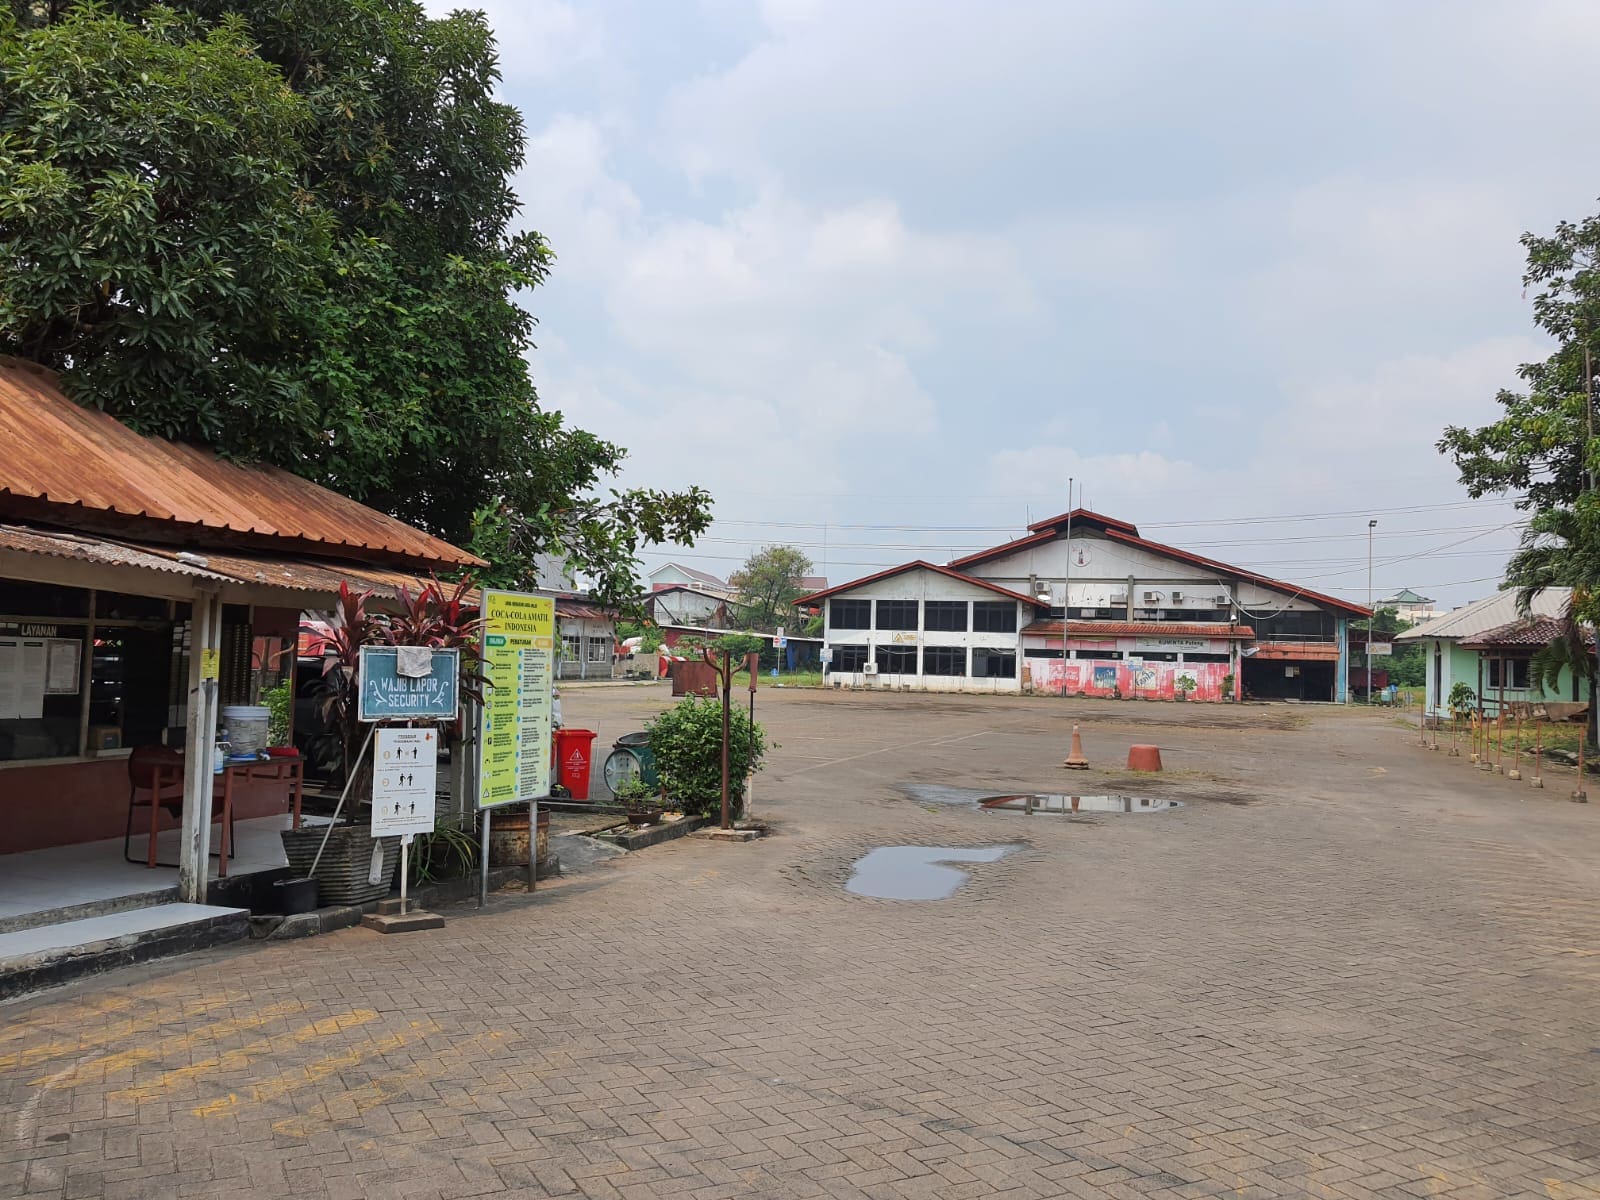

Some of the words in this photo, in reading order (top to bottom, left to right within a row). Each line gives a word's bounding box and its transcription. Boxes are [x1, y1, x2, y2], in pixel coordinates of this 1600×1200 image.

[491, 609, 527, 620] COCA-COLA
[528, 612, 548, 622] AMATIL
[21, 623, 57, 637] LAYANAN
[505, 622, 537, 632] INDONESIA
[381, 677, 408, 692] WAJIB
[410, 678, 438, 692] LAPOR
[388, 693, 430, 707] SECURITY
